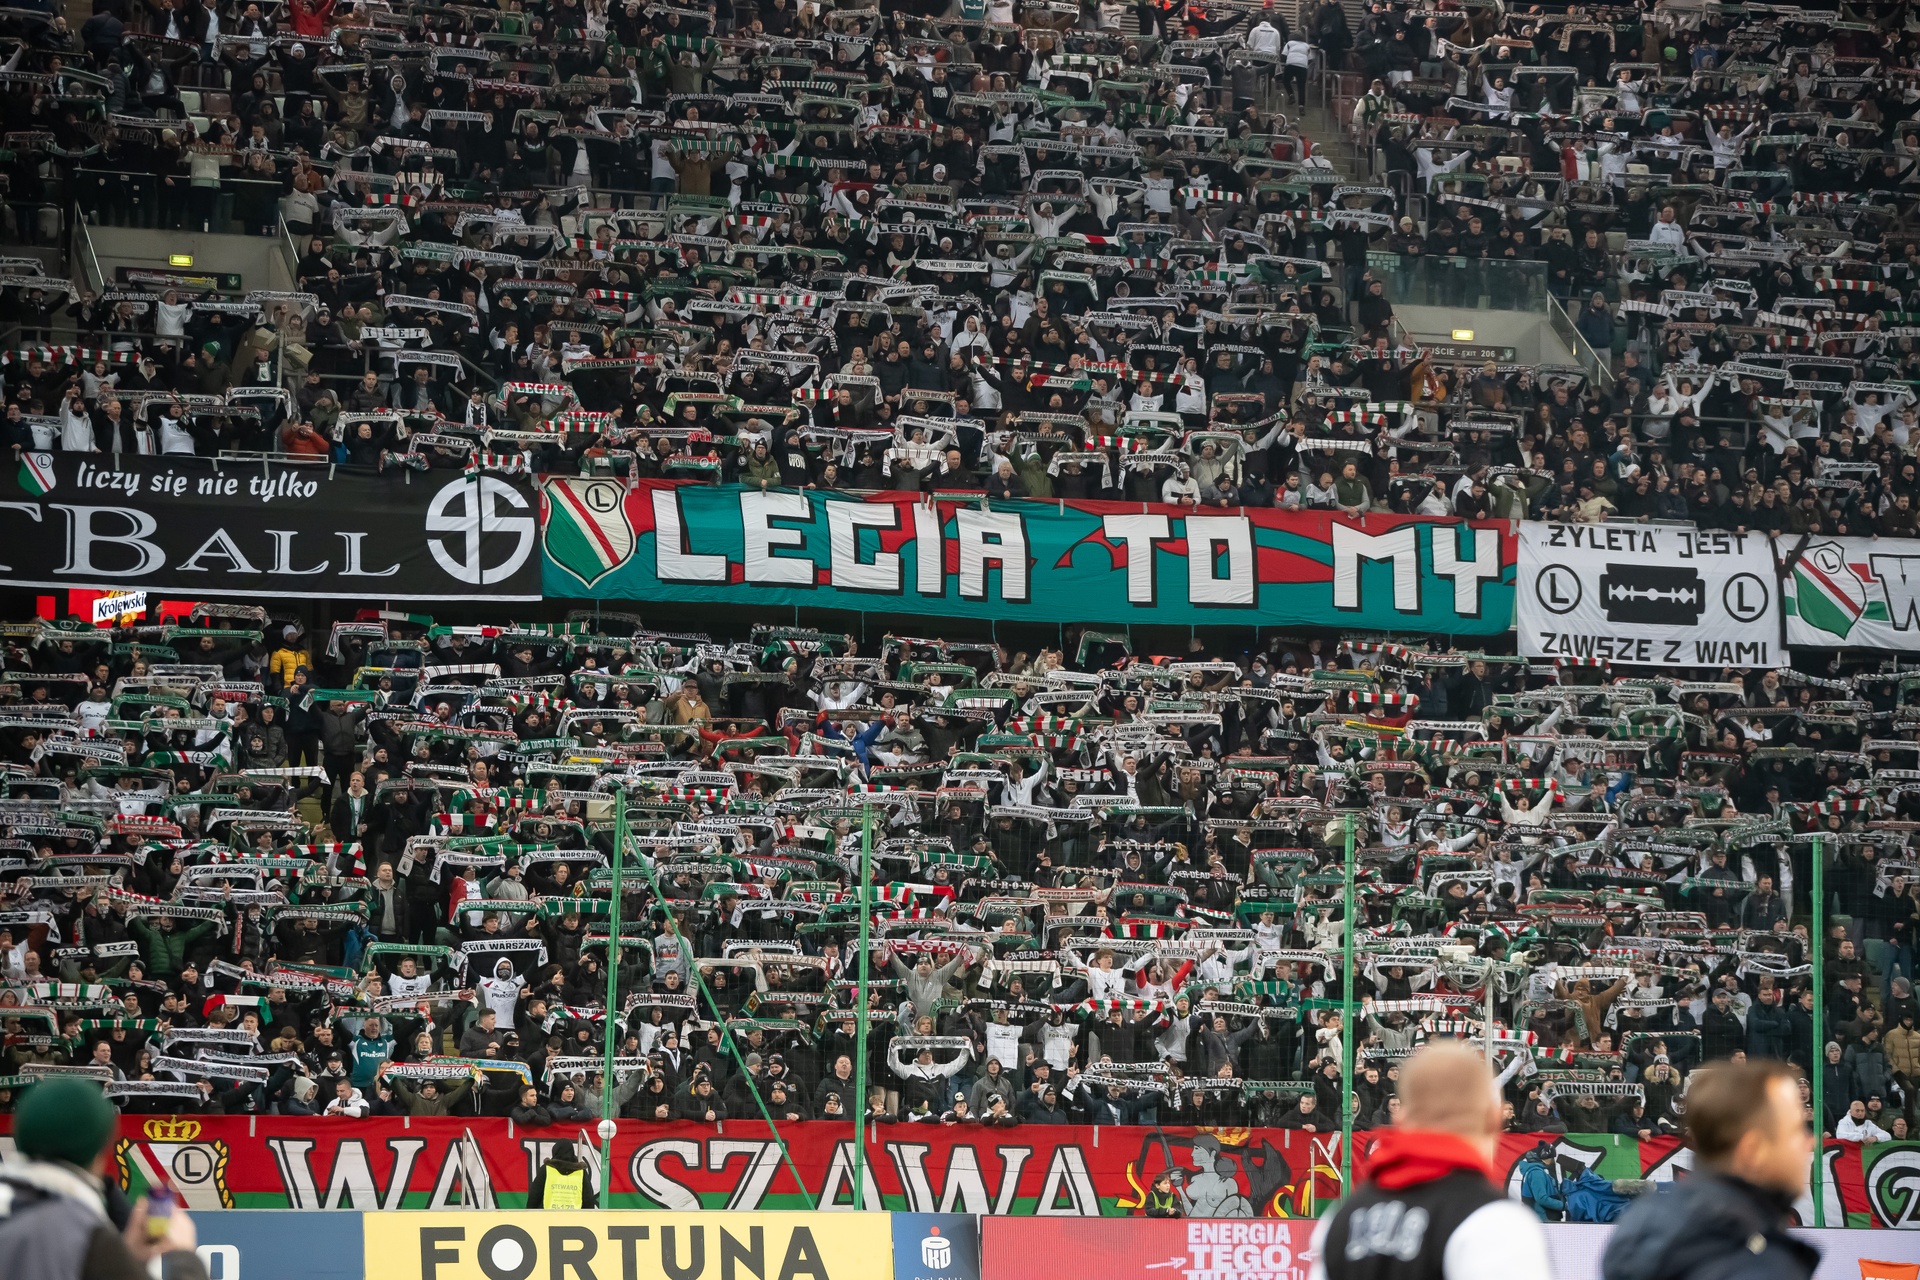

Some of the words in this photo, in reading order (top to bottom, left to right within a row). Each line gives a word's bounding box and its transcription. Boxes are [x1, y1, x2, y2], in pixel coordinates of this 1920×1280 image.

[1415, 10, 1464, 18] OCHOTA
[824, 34, 873, 46] STOLICA
[1384, 114, 1420, 124] LEGIA
[741, 204, 790, 215] STOLICA
[879, 224, 928, 235] LEGIA
[692, 301, 713, 309] LEGIA
[714, 303, 751, 311] WARSZAWA
[1820, 334, 1839, 342] LEGIA
[767, 353, 813, 363] WARSZAWA
[1481, 349, 1496, 358] 206
[1084, 360, 1121, 372] LEGIA
[1731, 365, 1748, 373] LEGIA
[1750, 366, 1788, 378] WARSZAWA
[515, 383, 559, 395] LEGIA
[571, 411, 612, 422] LEGIA
[1469, 422, 1512, 431] WARSZAWA
[675, 458, 698, 467] DEYNA
[77, 462, 141, 496] liczy
[151, 471, 188, 497] się
[198, 475, 238, 495] nie
[249, 471, 318, 502] tylko
[0, 502, 400, 577] BALL
[1677, 532, 1749, 558] JEST
[651, 490, 1028, 600] LEGIA
[1102, 514, 1255, 605] TO
[1332, 521, 1500, 614] MY
[1550, 573, 1569, 603] L
[1738, 582, 1755, 612] L
[1540, 632, 1653, 661] ZAWSZE
[1664, 640, 1681, 662] Z
[1696, 641, 1767, 664] WAMI
[1037, 694, 1054, 702] LEGIA
[1055, 692, 1095, 702] WARSZAWA
[1110, 690, 1173, 700] STOLICA
[497, 753, 556, 763] STOLICA
[884, 763, 940, 773] OTWOCK
[1390, 762, 1411, 770] LEGIA
[574, 791, 612, 800] WARSZAWA
[1431, 789, 1458, 798] CWKS
[1459, 791, 1486, 802] LEGIA
[1094, 798, 1136, 806] WARSZAWA
[117, 814, 168, 826] LEGIA
[559, 852, 601, 860] WARSZAWA
[268, 859, 308, 867] WARSZAWA
[63, 877, 107, 885] WARSZAWA
[590, 880, 649, 889] URSNÓW
[137, 906, 154, 915] NIE
[489, 941, 543, 951] WARSZAWA
[893, 942, 956, 951] LEGIA
[774, 955, 824, 966] WARSZAWA
[631, 995, 653, 1005] LEGIA
[764, 993, 824, 1003] URSYNÓW
[396, 1066, 470, 1077] BIAŁOŁĘKA
[1188, 1223, 1291, 1243] ENERGIA
[420, 1225, 829, 1280] FORTUNA
[1188, 1244, 1291, 1270] TEGO
